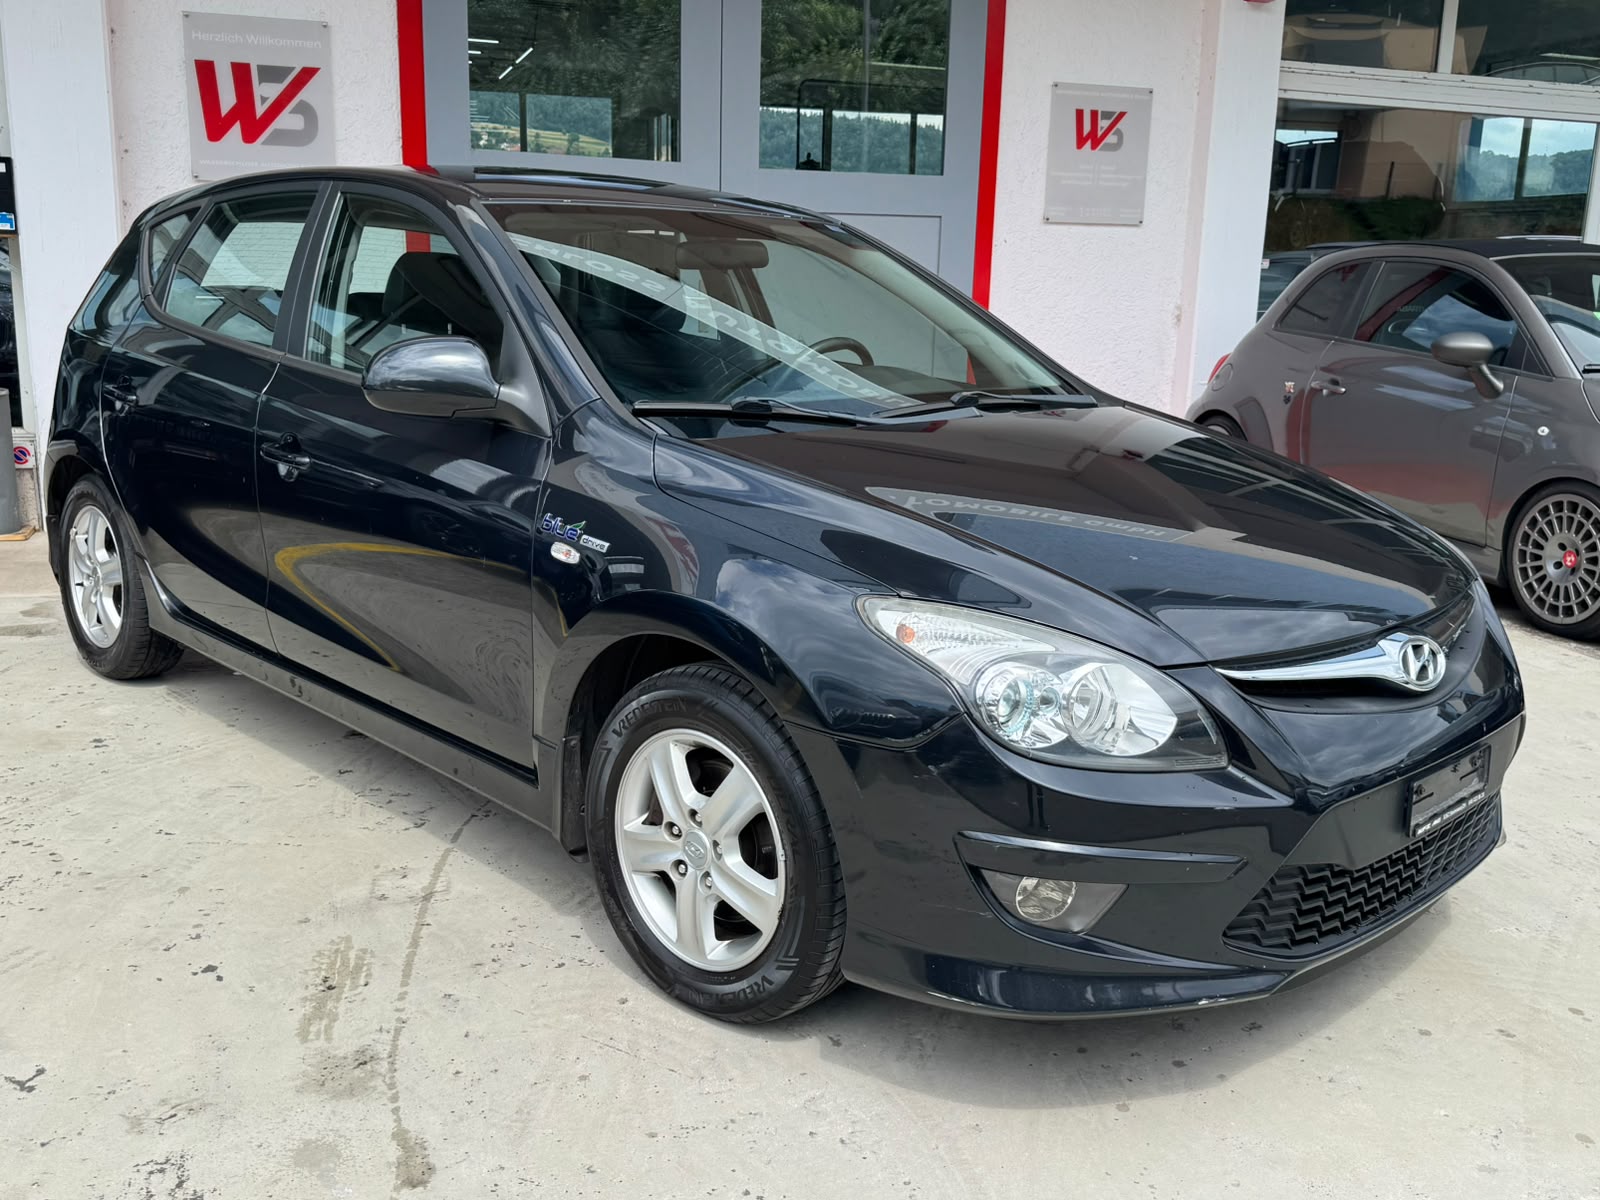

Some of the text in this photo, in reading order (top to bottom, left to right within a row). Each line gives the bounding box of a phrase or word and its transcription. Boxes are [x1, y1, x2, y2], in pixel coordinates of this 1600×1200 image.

[191, 30, 322, 49] Herzlich Willkommen
[541, 513, 606, 550] blue drive
